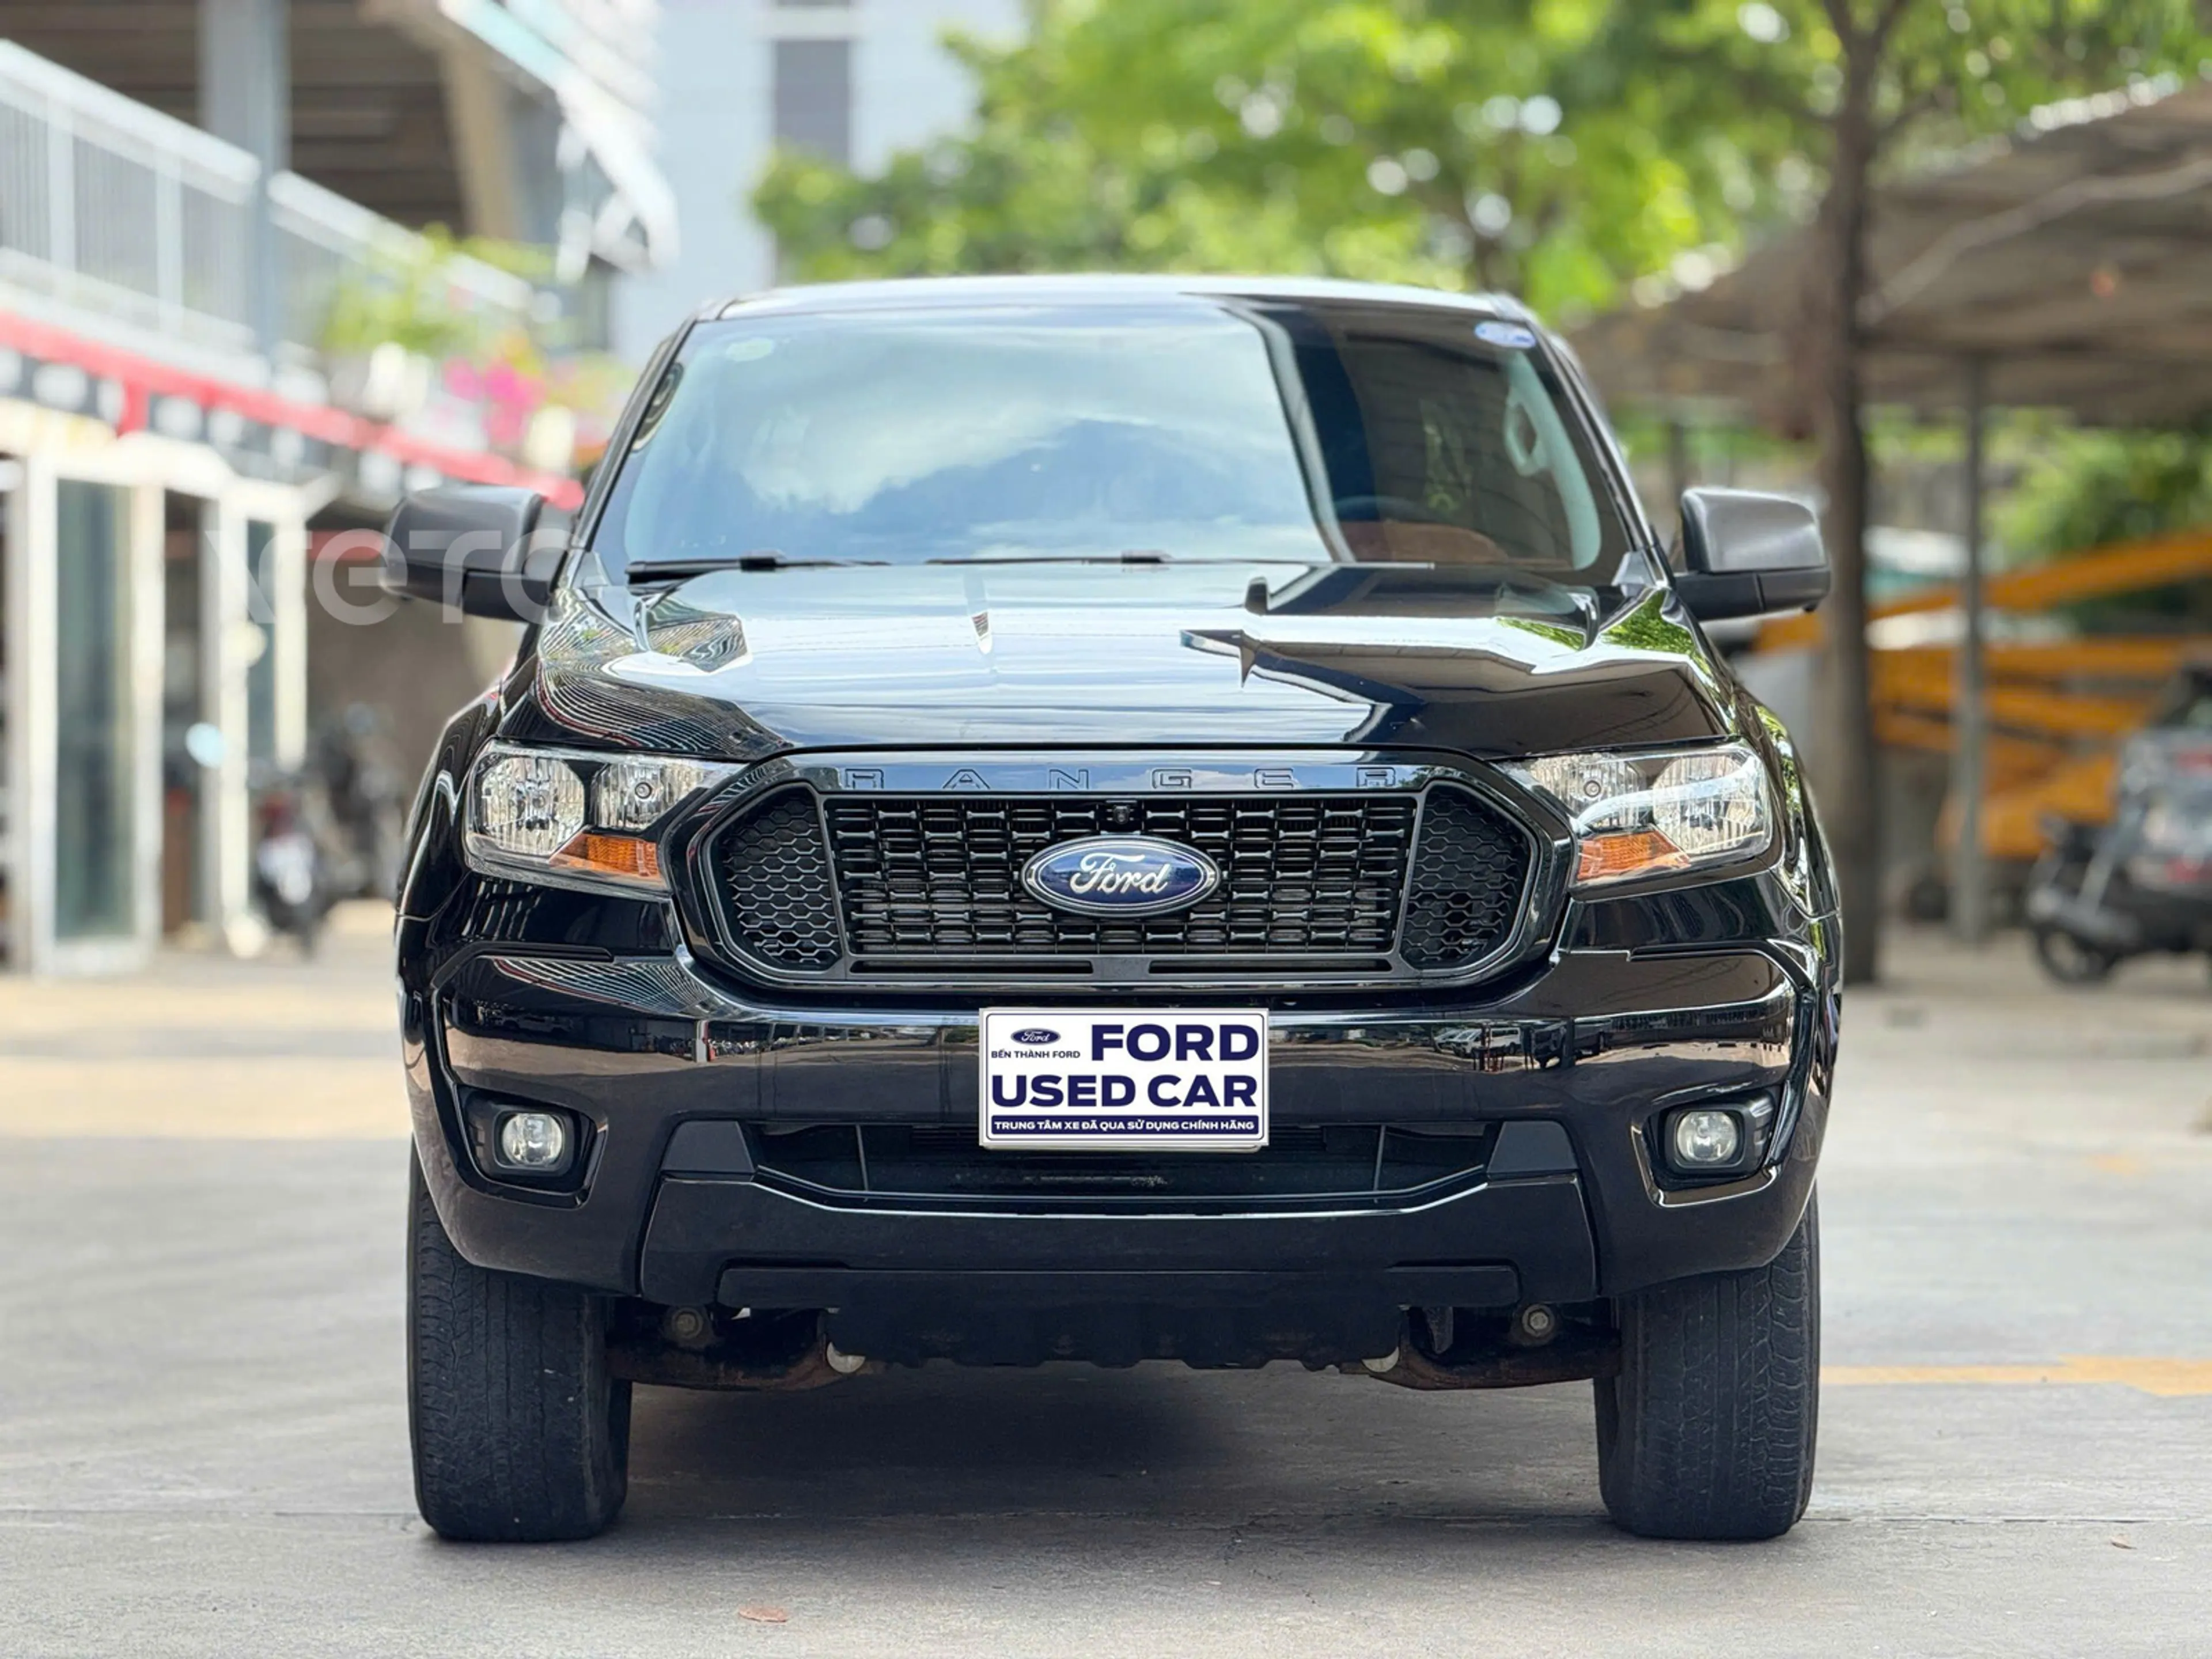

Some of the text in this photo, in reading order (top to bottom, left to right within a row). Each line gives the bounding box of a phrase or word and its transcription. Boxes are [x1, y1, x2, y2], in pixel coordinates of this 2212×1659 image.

[844, 767, 1396, 790] RANGER
[1070, 853, 1171, 893] Ford
[1020, 1031, 1051, 1042] Ford
[1092, 1024, 1259, 1061] FORD
[991, 1048, 1081, 1058] BẾN THÀNH FORD
[992, 1074, 1257, 1107] USED CAR
[994, 1119, 1255, 1131] TRUNG TÂM XE ĐÃ QUA SỬ DỤNG CHÍNH HÃNG
